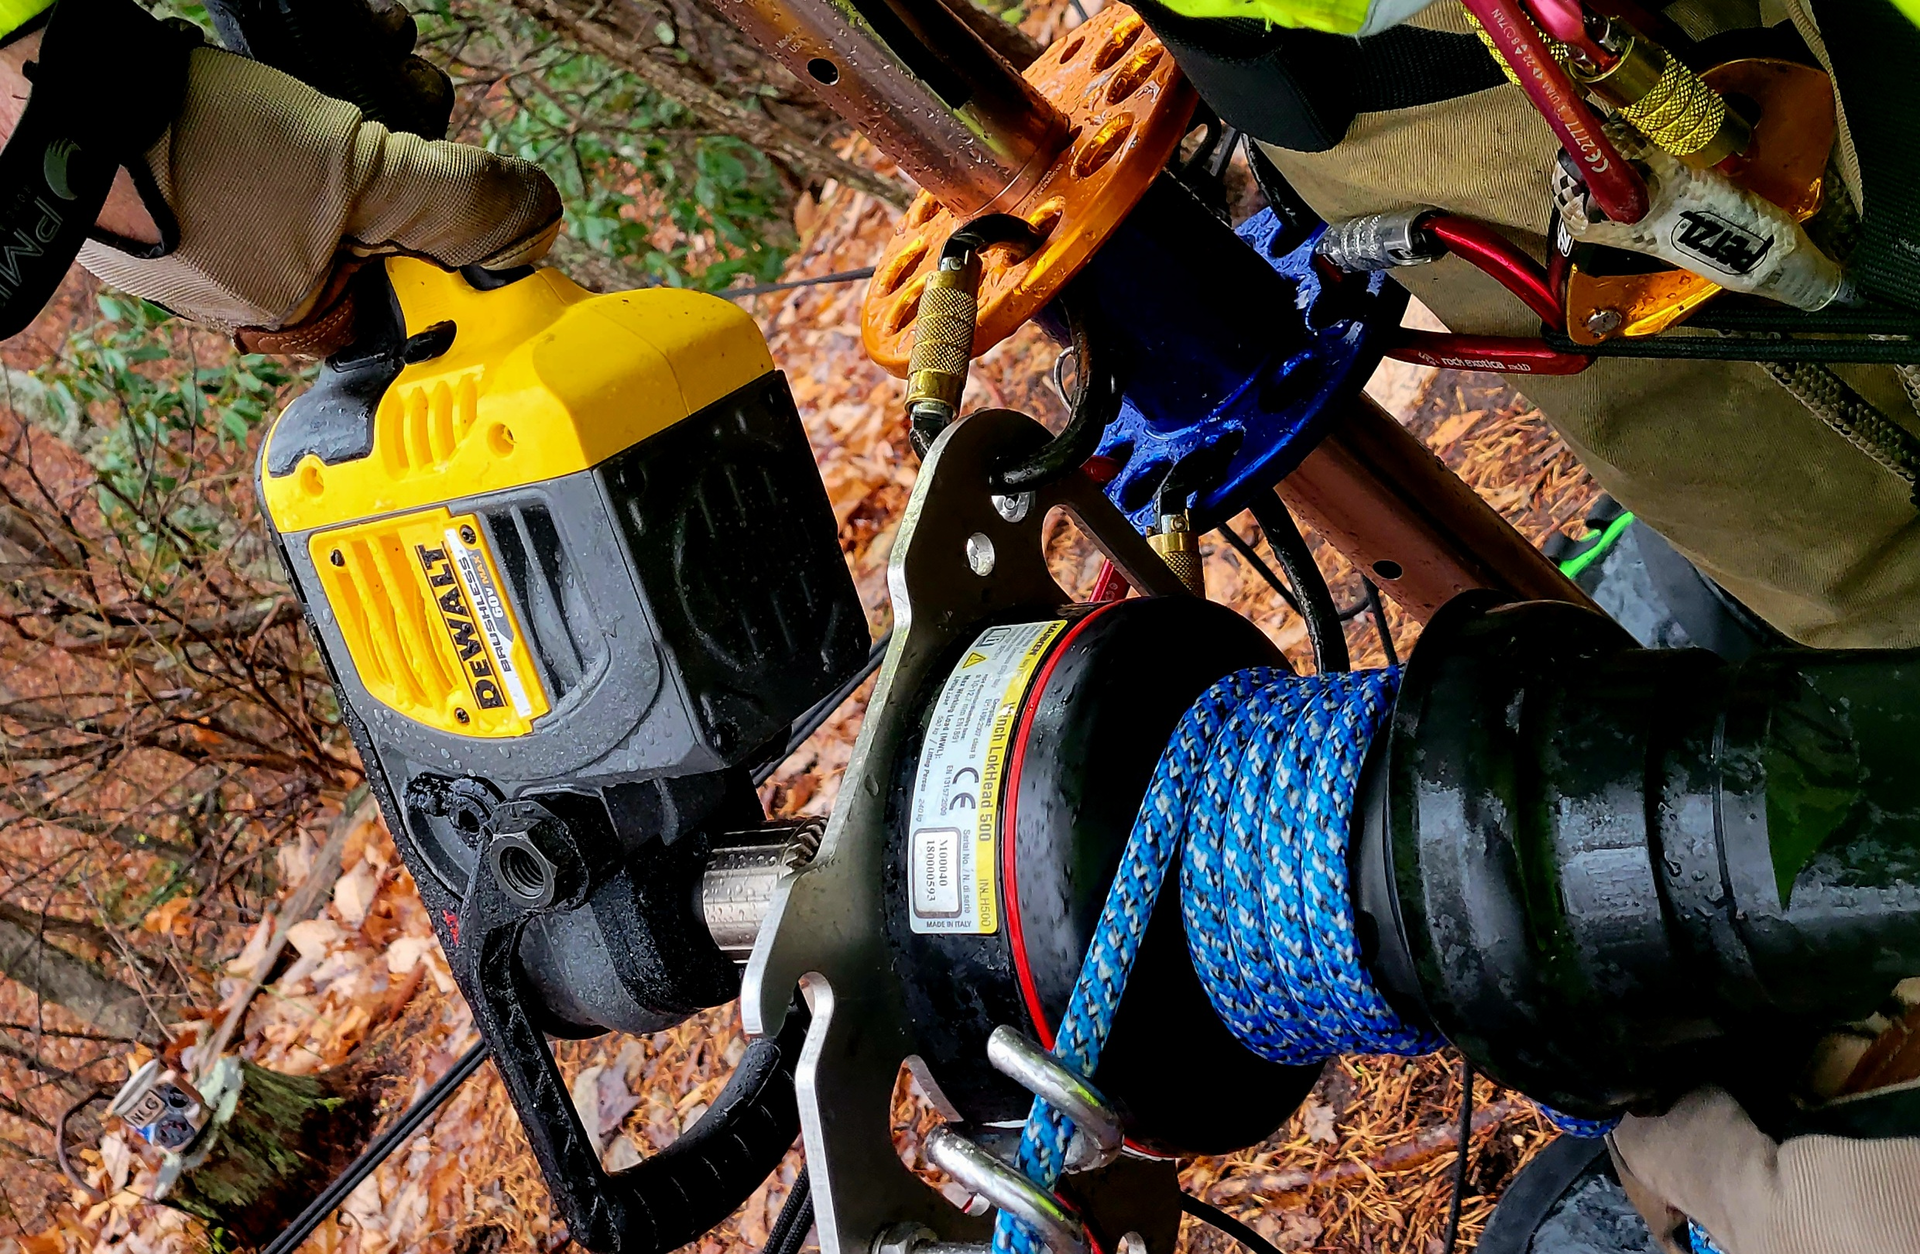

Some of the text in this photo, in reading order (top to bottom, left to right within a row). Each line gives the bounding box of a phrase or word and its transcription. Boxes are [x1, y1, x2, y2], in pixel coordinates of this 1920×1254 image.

[1491, 8, 1509, 28] 7kN
[1522, 53, 1536, 67] 22
[1564, 118, 1596, 152] 2777
[1677, 211, 1773, 274] PETZL
[472, 555, 490, 585] MAX
[458, 556, 511, 672] BRUSHLESS
[943, 715, 954, 731] Load
[945, 766, 953, 775] EN
[981, 747, 1002, 809] LokHead
[963, 830, 971, 851] Serial
[979, 814, 992, 842] 500
[926, 841, 935, 901] 180000593
